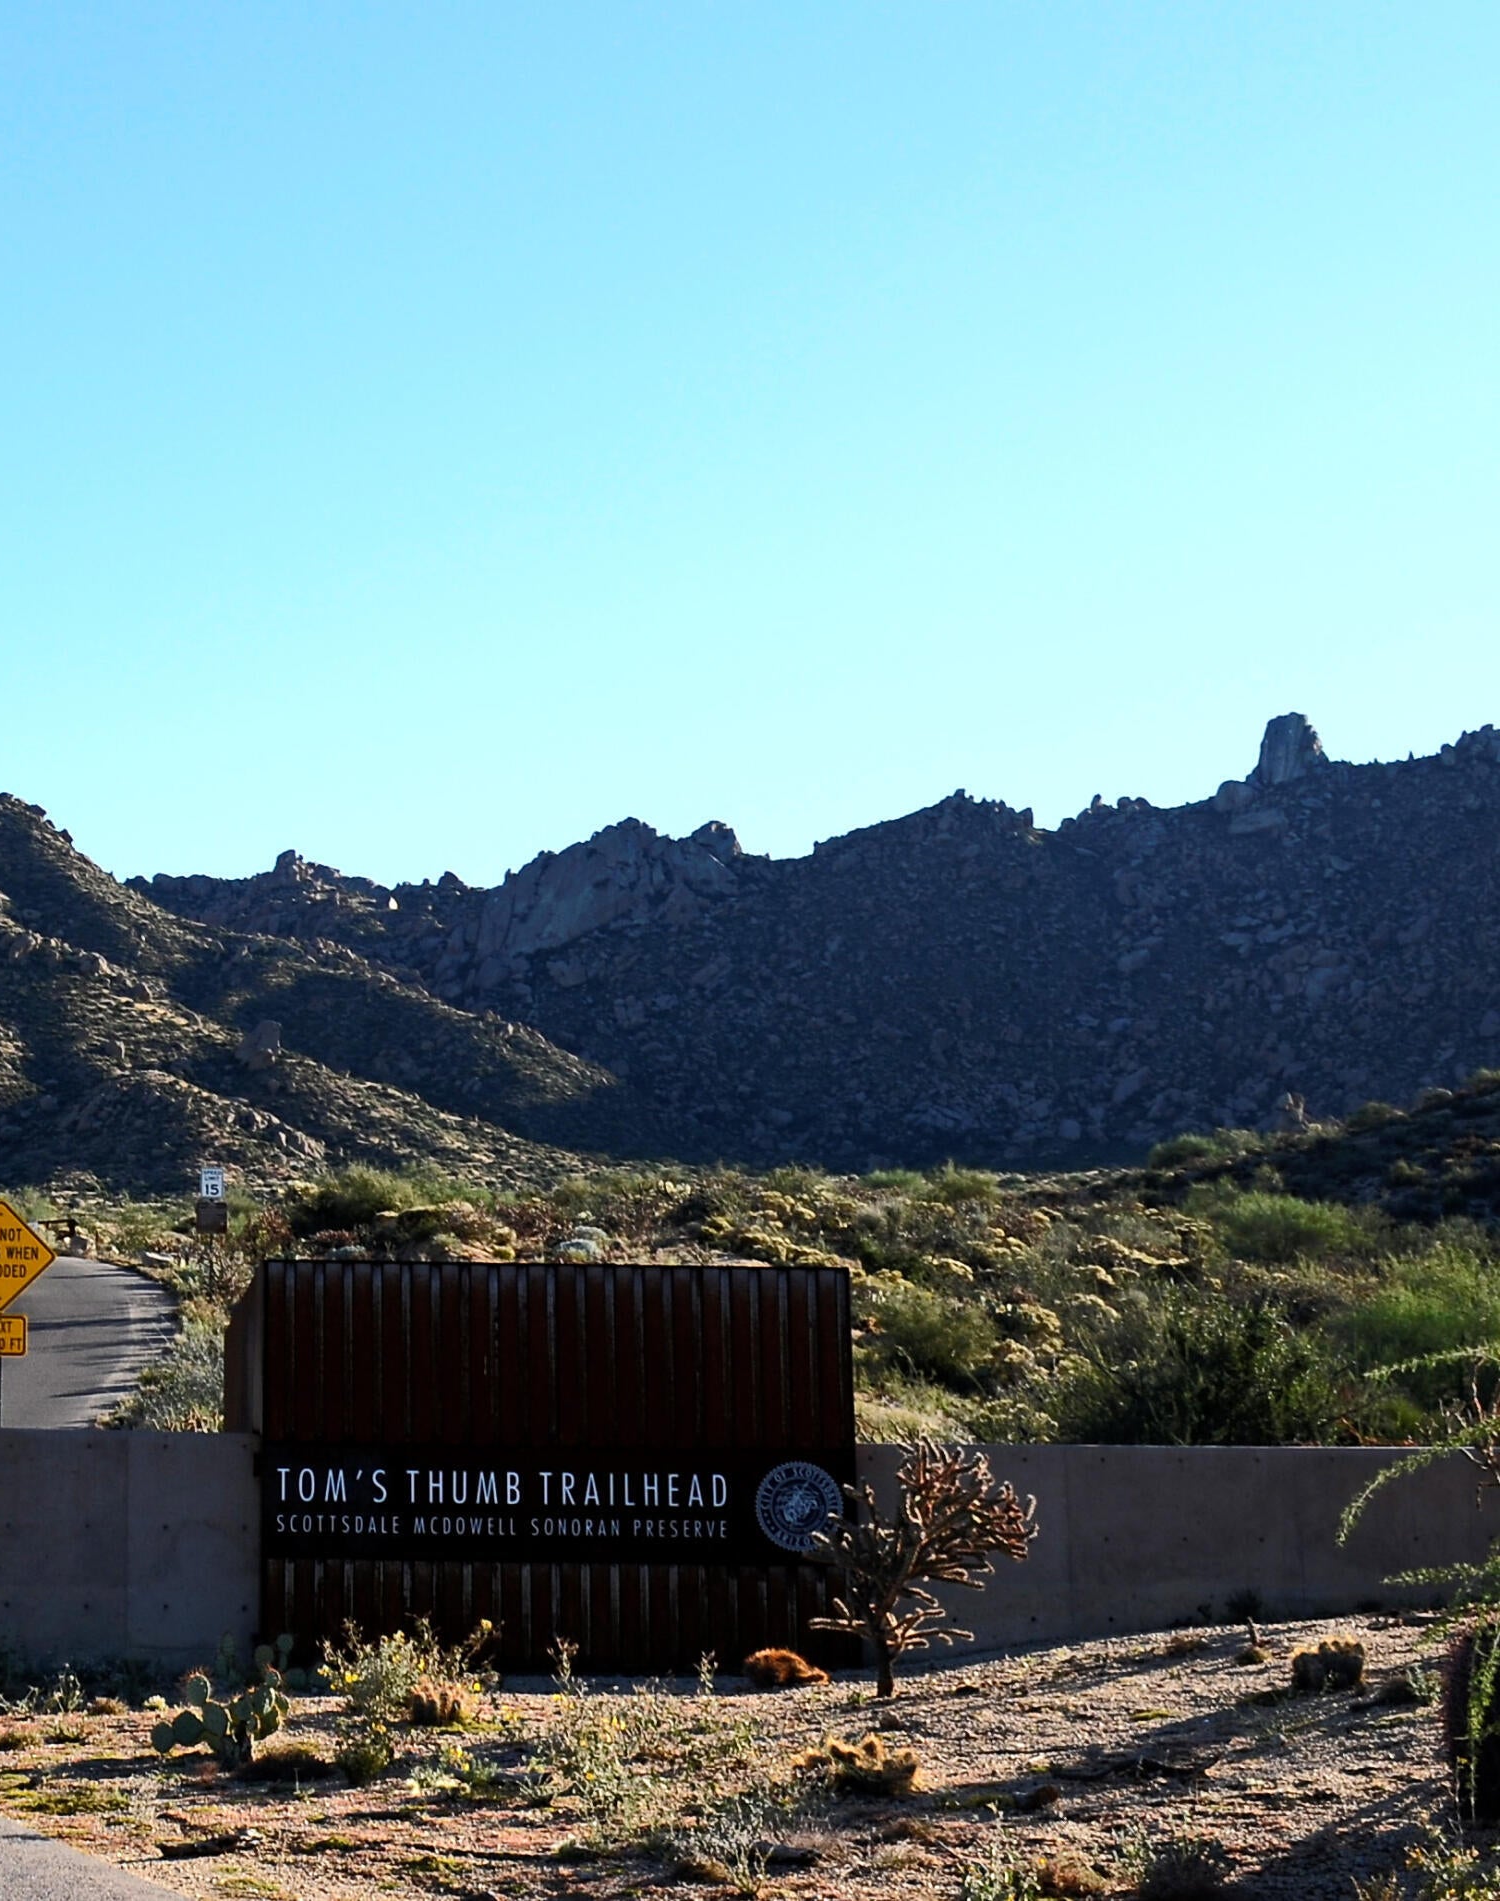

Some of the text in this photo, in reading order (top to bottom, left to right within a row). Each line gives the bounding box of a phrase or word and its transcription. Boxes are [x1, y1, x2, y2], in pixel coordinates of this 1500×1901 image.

[205, 1184, 219, 1195] 15
[0, 1228, 22, 1241] NOT
[6, 1246, 39, 1260] WHEN
[10, 1338, 22, 1350] FT
[277, 1468, 728, 1507] TOM'S THUMB TRAILHEAD
[276, 1514, 727, 1538] SCOTTSDALE MCDOWELL SONORAN PRESERVE
